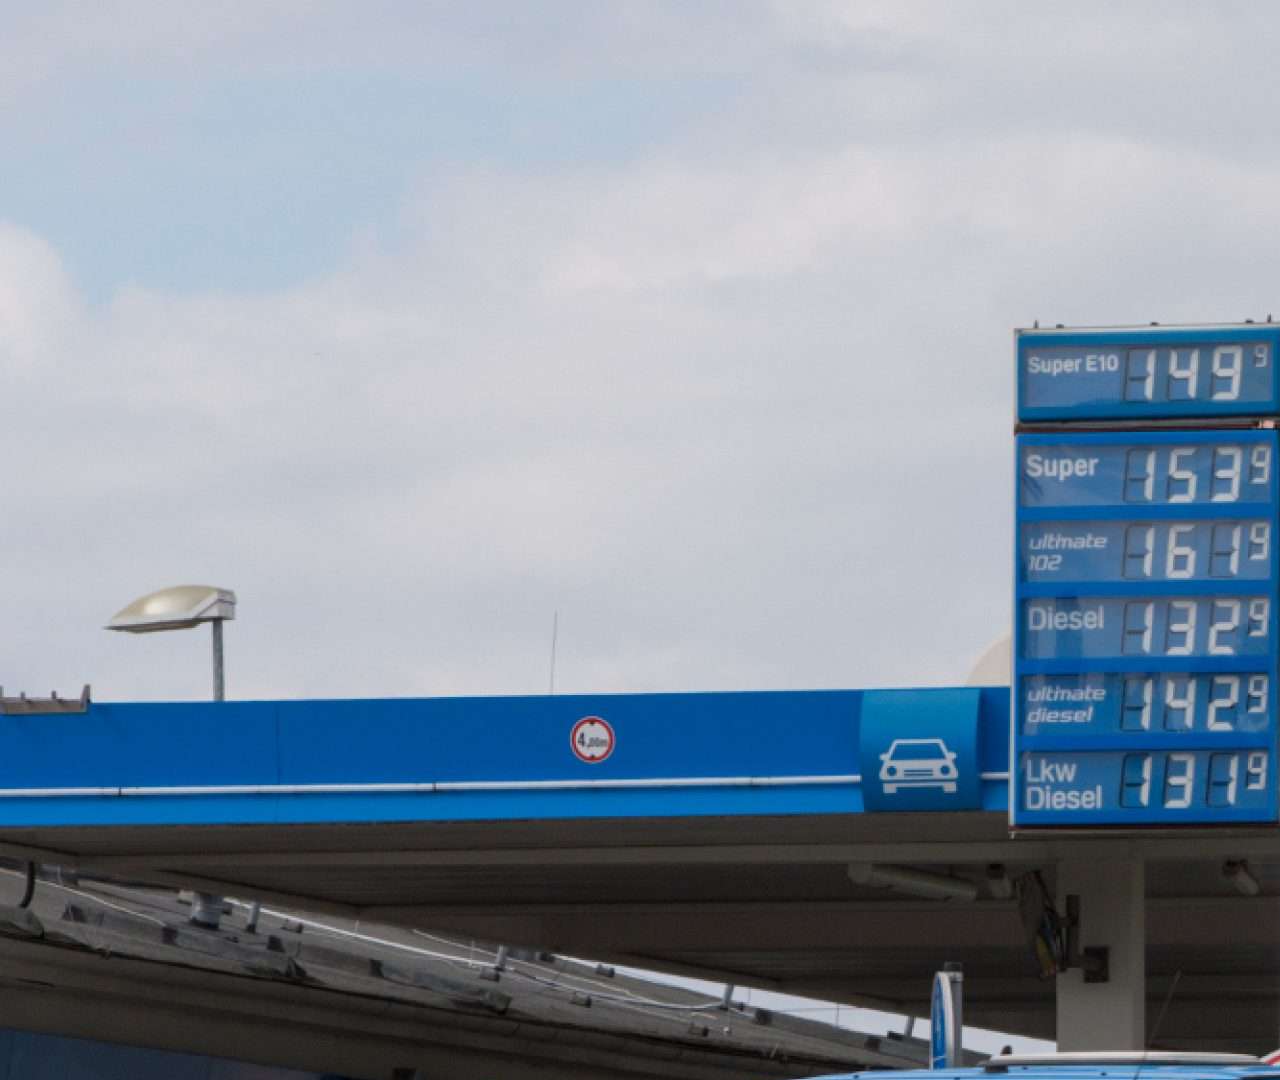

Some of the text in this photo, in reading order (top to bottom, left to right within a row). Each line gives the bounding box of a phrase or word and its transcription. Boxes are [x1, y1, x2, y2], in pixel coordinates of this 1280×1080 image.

[1027, 356, 1082, 376] Super
[1086, 354, 1119, 372] E10
[1026, 455, 1099, 482] Super
[1029, 533, 1107, 549] ultimate
[1029, 555, 1062, 571] 102
[1028, 605, 1105, 632] Diesel
[1027, 685, 1106, 702] ultimate
[1027, 706, 1094, 723] diesel
[1025, 759, 1077, 783] Lkw
[1025, 785, 1103, 810] Diesel
